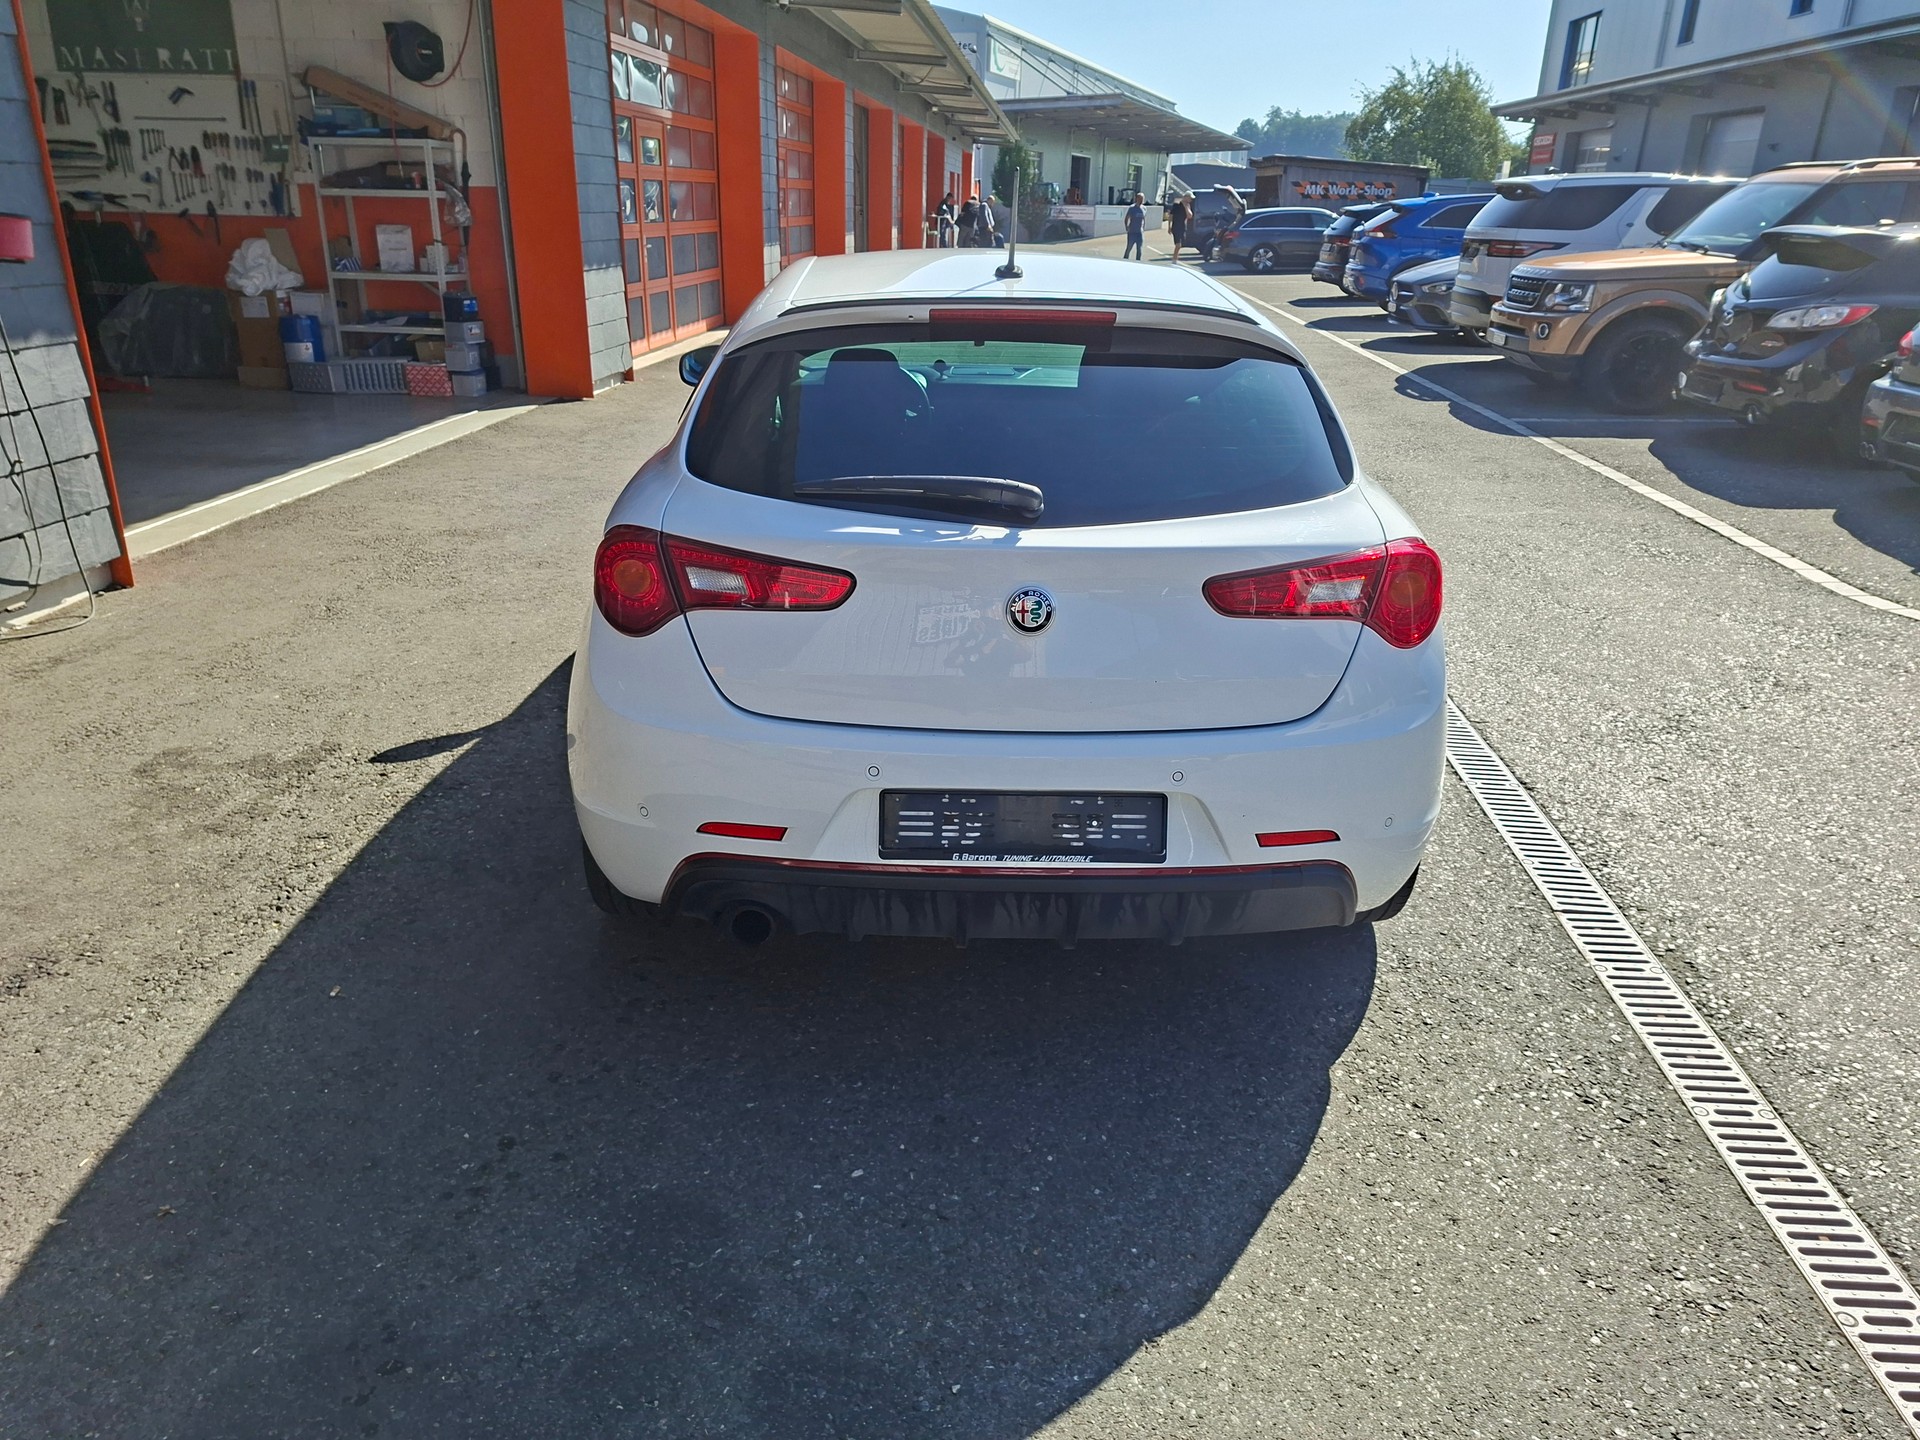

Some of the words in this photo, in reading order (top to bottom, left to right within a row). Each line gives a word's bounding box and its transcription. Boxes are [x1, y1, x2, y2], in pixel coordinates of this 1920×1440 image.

[1304, 184, 1325, 196] MK
[1328, 184, 1393, 199] Work-Shop
[1010, 593, 1025, 612] ALFA
[1028, 590, 1052, 612] ROMEO
[1039, 855, 1093, 863] AUTOMOBILE
